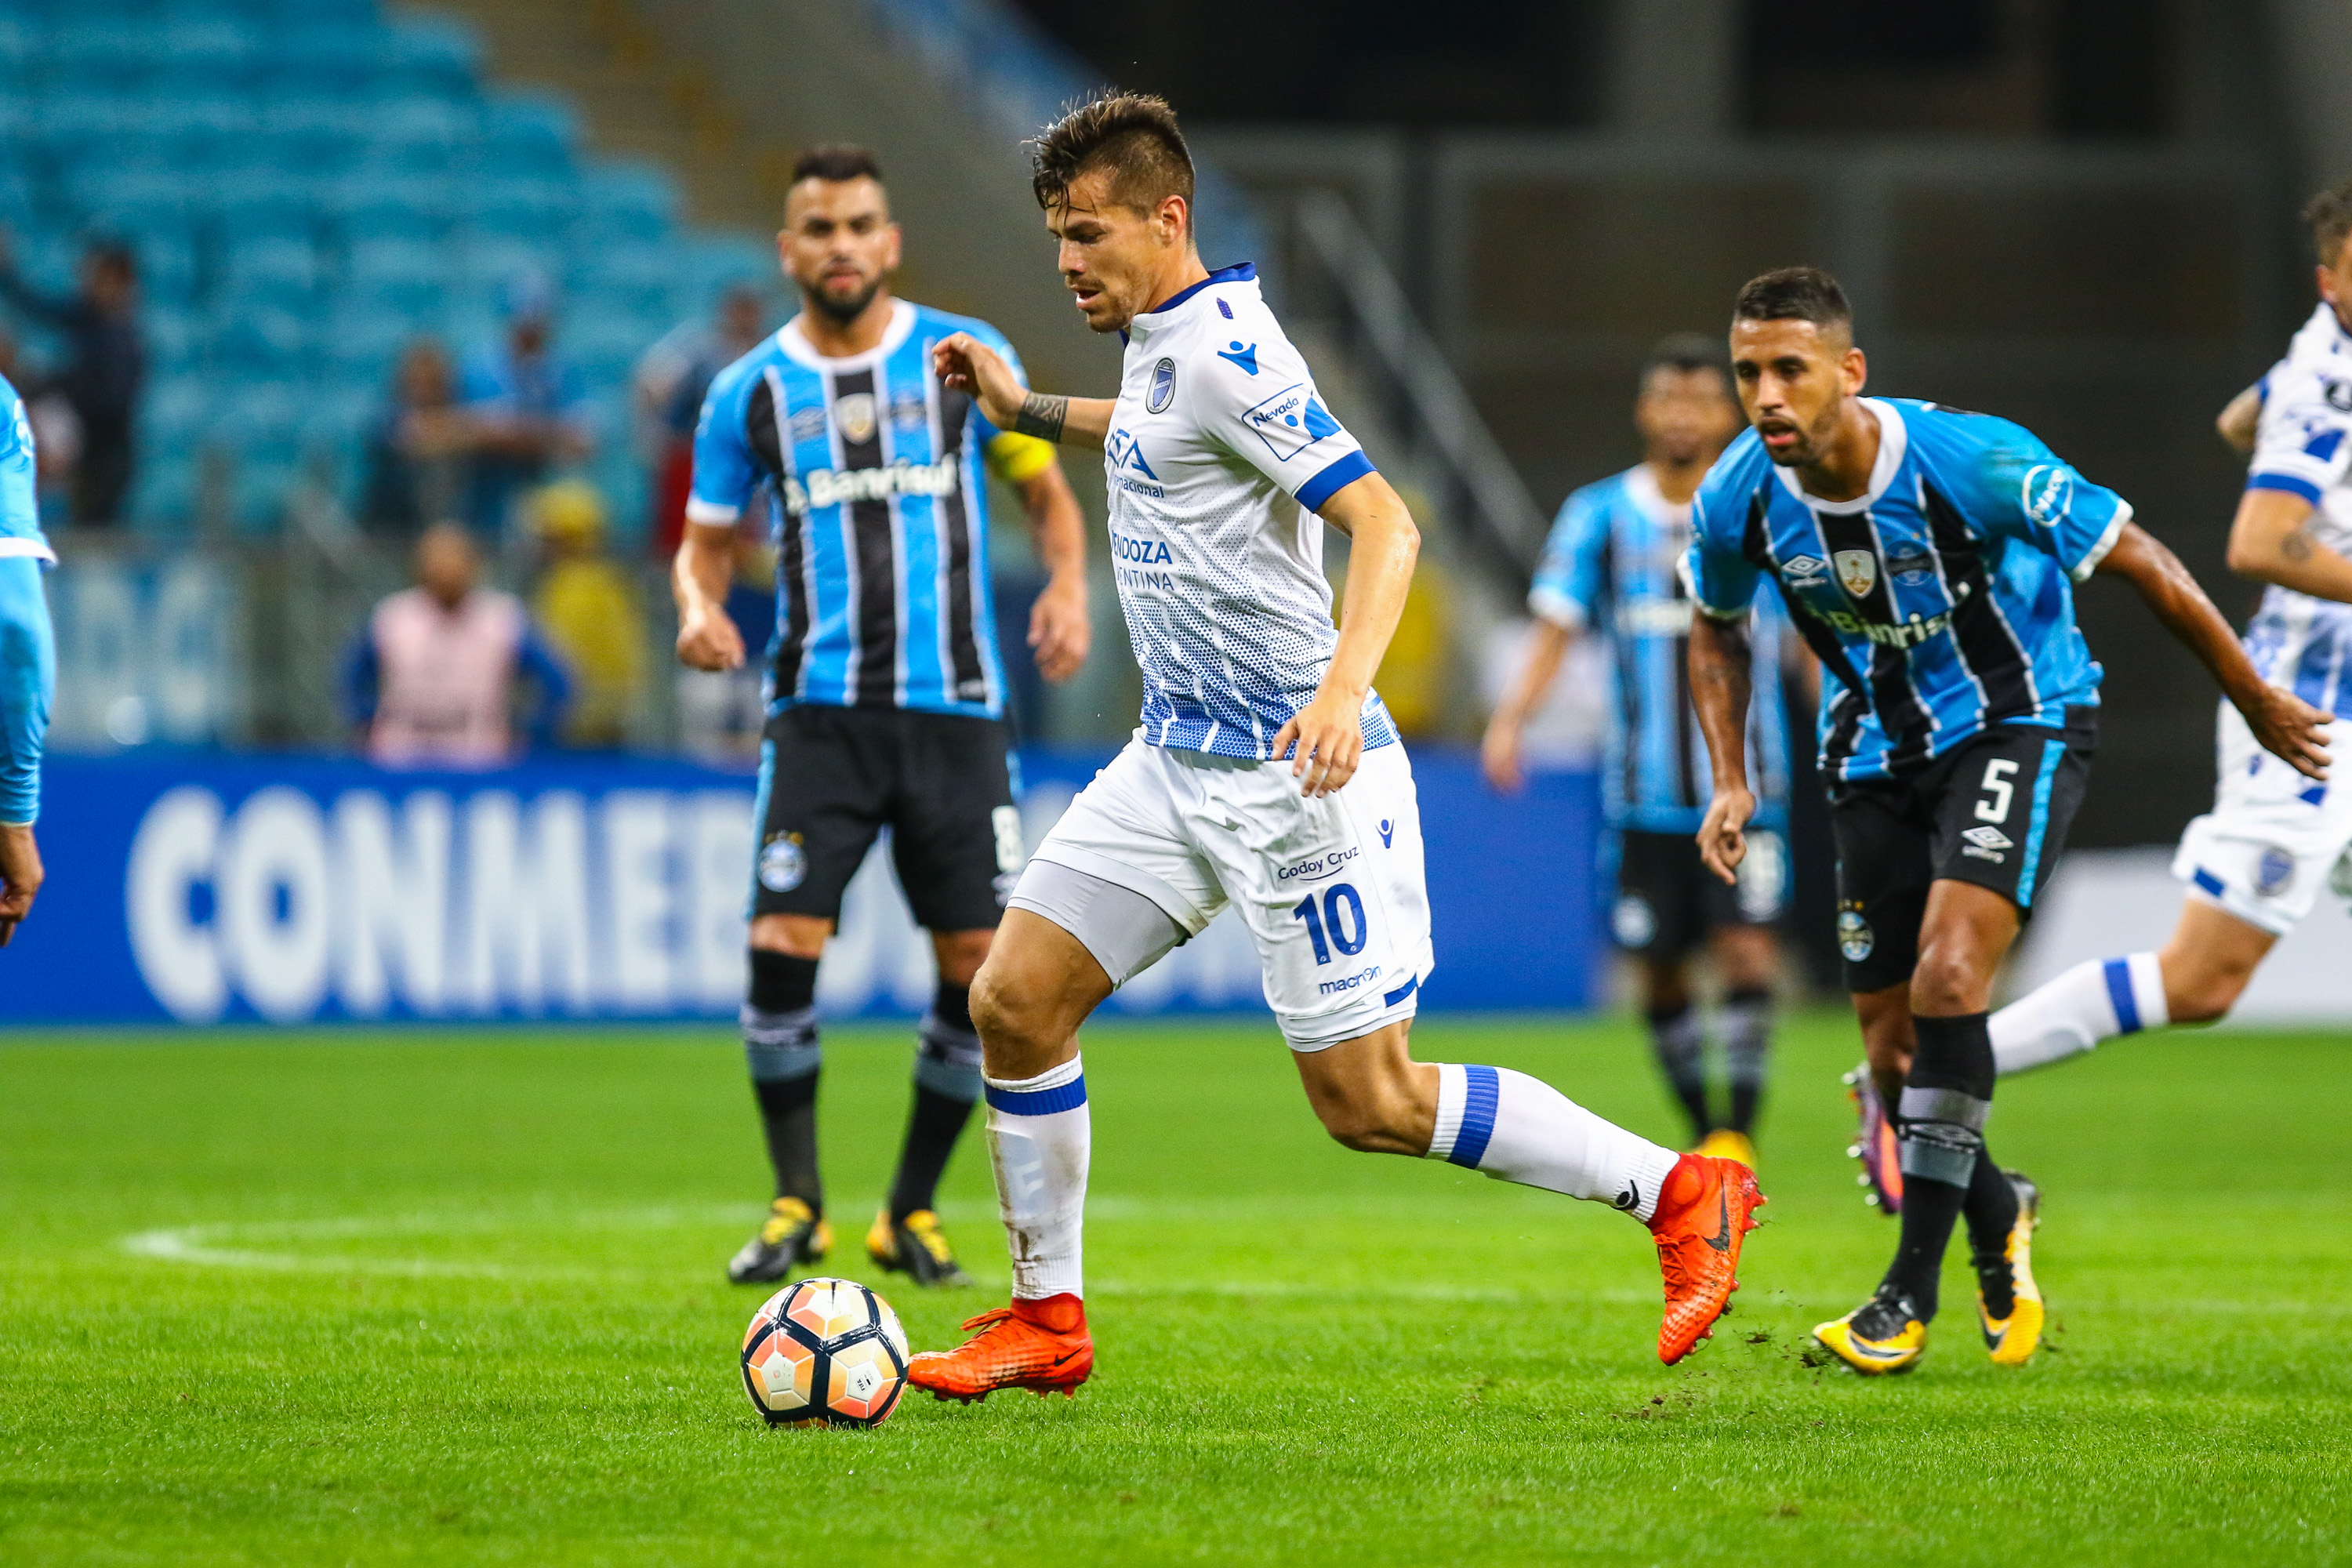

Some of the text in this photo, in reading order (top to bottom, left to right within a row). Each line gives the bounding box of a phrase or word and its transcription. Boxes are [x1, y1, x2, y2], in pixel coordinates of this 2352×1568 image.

[1251, 397, 1300, 428] Nevada
[807, 452, 957, 508] Banrisul
[1973, 757, 2020, 825] 5
[990, 804, 1024, 873] 8
[1278, 846, 1359, 880] Godoy Cruz
[1293, 882, 1367, 966] 10
[1319, 965, 1383, 995] macron
